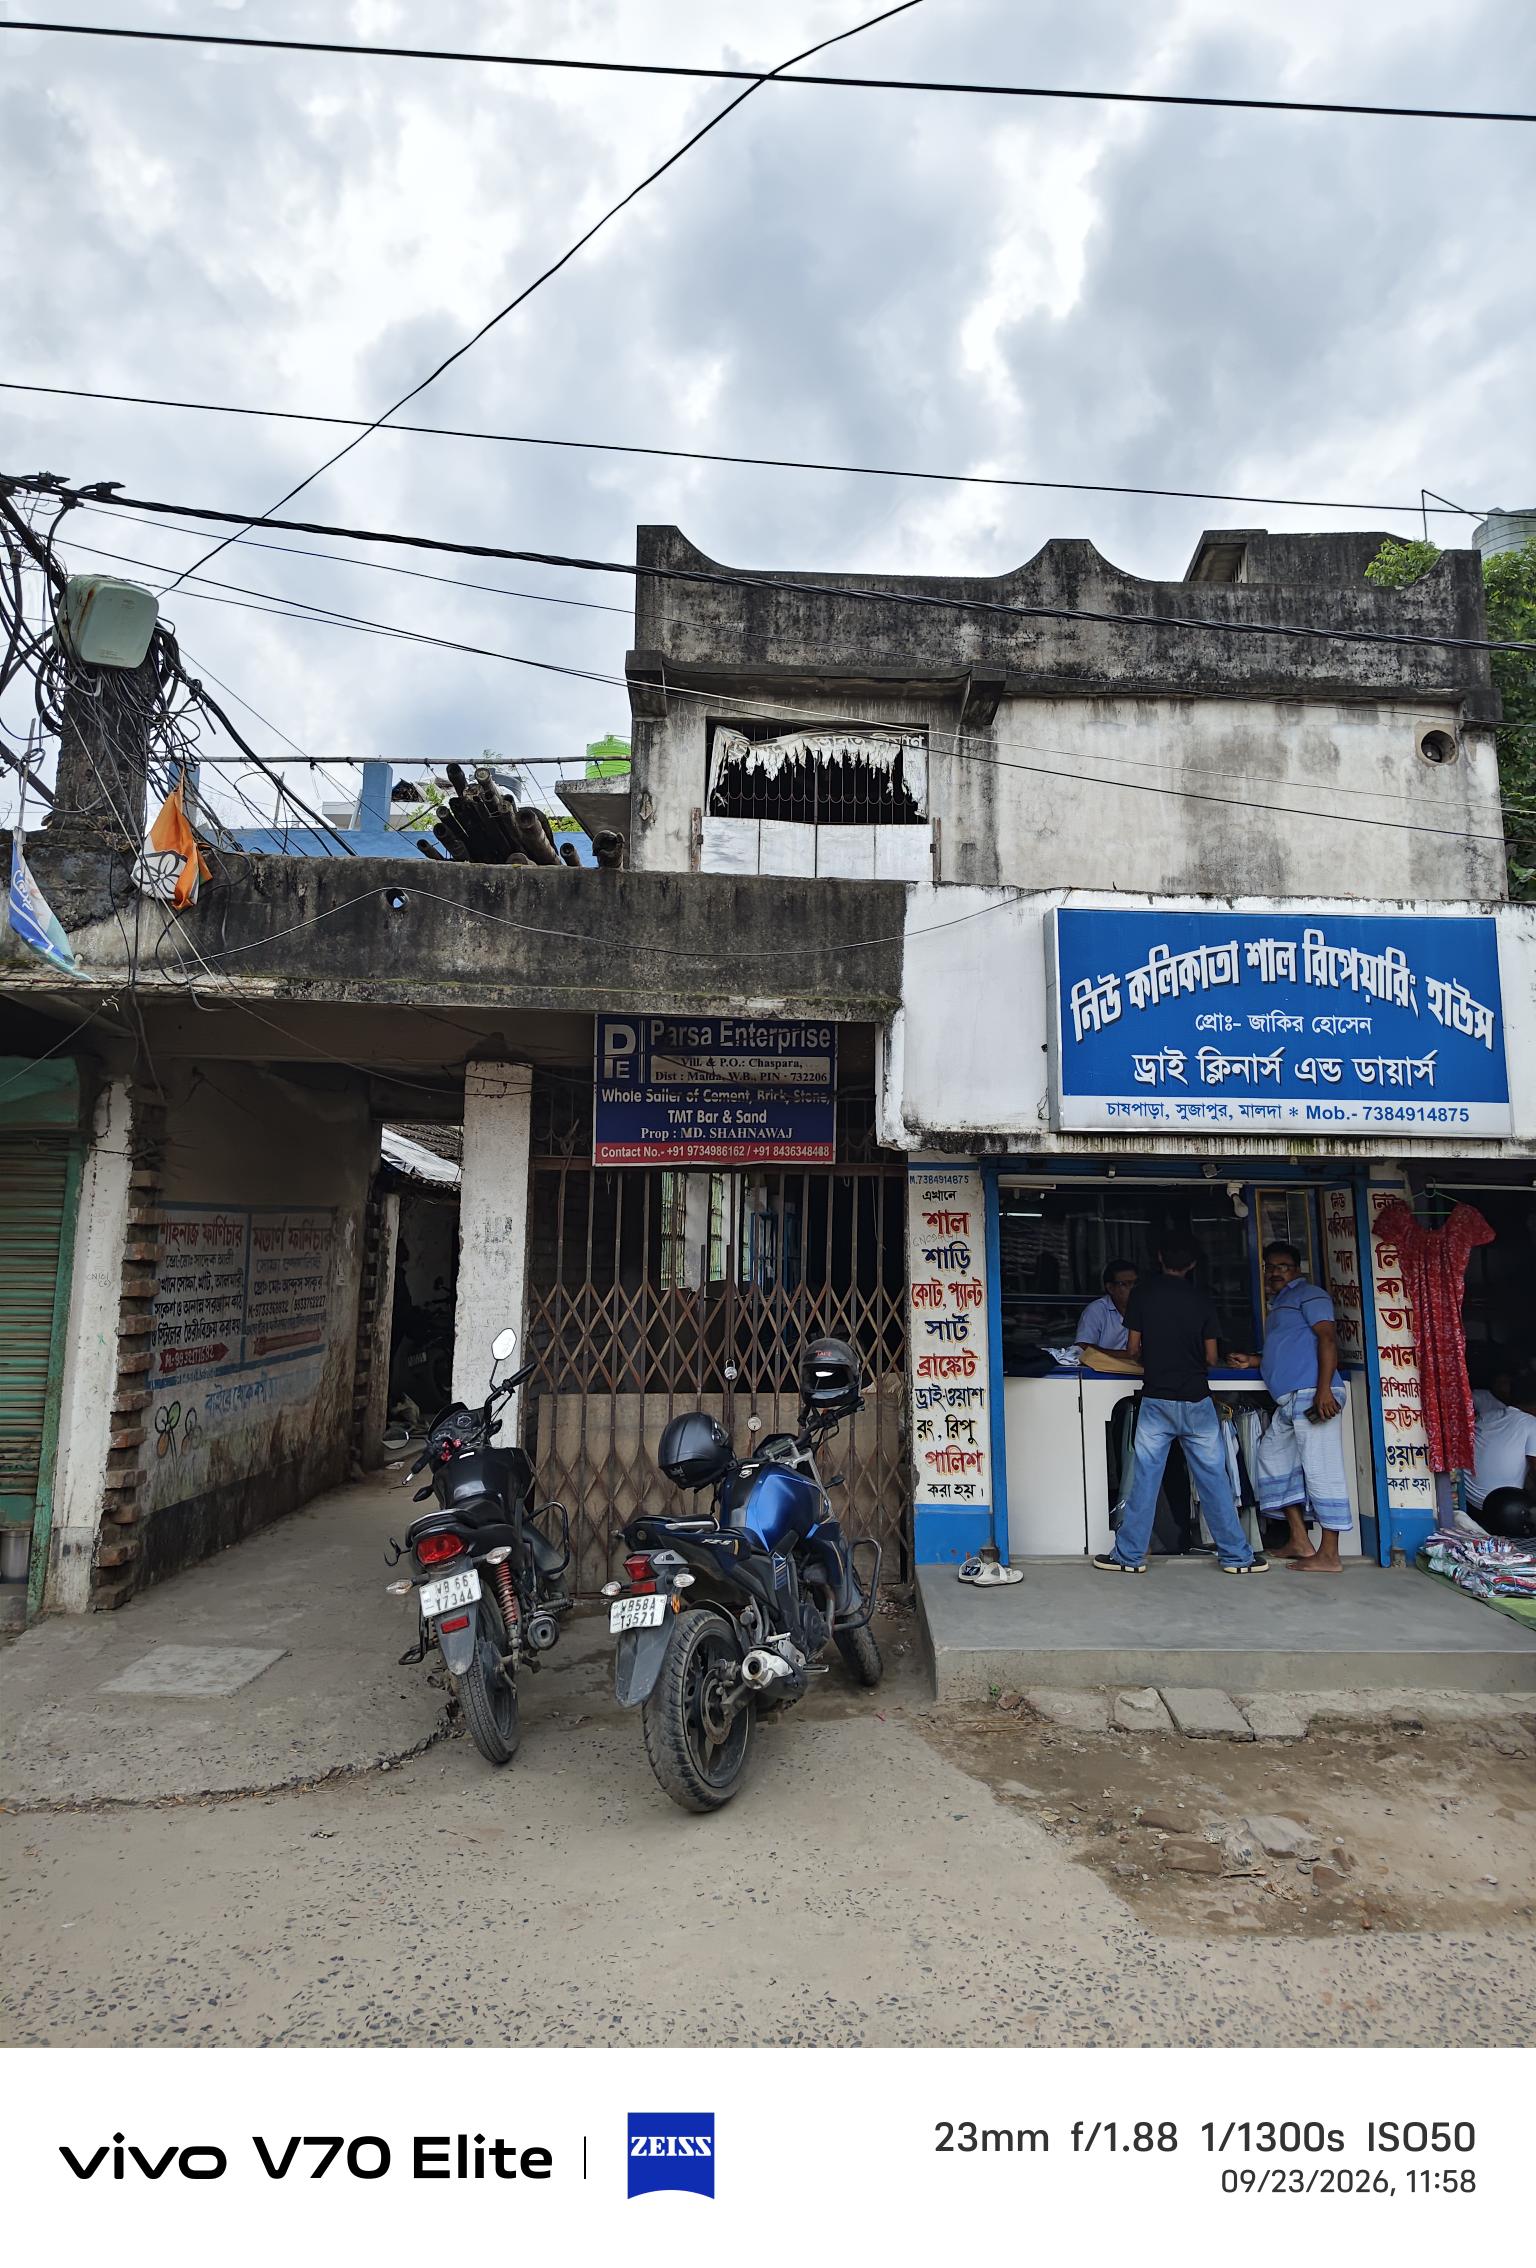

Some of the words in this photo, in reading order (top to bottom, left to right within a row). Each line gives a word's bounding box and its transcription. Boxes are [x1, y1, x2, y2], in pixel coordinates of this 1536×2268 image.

[1070, 973, 1122, 1042] নিউ
[1125, 943, 1240, 1010] কলিকাতা
[1244, 938, 1297, 982] শাল
[1302, 928, 1419, 1018] রিপেয়ারিং
[1425, 976, 1495, 1050] হাউস
[1247, 1010, 1304, 1033] জাকির
[1311, 1015, 1372, 1036] হোসেন
[650, 1019, 713, 1046] Parsa
[719, 1020, 831, 1054] Enterprise
[748, 1058, 803, 1069] Chaspara,
[1131, 1046, 1188, 1087] ড্রাই
[1195, 1045, 1285, 1086] ক্লিনার্স
[1294, 1056, 1344, 1085] এন্ড
[1350, 1049, 1438, 1087] ডায়ার্স
[655, 1071, 678, 1081] Dist
[760, 1072, 780, 1081] PIN
[790, 1072, 828, 1082] 732206
[602, 1088, 642, 1102] Whole
[667, 1109, 693, 1124] TMT
[697, 1110, 718, 1124] Bar
[722, 1110, 732, 1124] &
[736, 1109, 767, 1124] Sand
[1105, 1102, 1170, 1120] চাষপাড়া,
[1175, 1103, 1233, 1120] সুজাপুর,
[1239, 1104, 1282, 1119] মালদা
[1306, 1105, 1357, 1120] Mob.-
[1363, 1106, 1470, 1122] 7384914875
[641, 1128, 669, 1141] Prop
[681, 1127, 706, 1139] MD.
[709, 1127, 793, 1139] SHAHNAWAJ
[602, 1146, 641, 1158] Contact
[667, 1145, 685, 1157] +91
[687, 1145, 745, 1157] 9734986162
[753, 1146, 771, 1156] +91
[922, 1190, 958, 1202] এখানে
[922, 1209, 971, 1236] শাল
[921, 1240, 971, 1276] শাড়ি
[948, 1276, 984, 1312] প্যান্ট
[924, 1313, 970, 1341] সার্ট
[1378, 1344, 1418, 1367] শাল
[1380, 1376, 1421, 1398] রিপিয়ারি
[1384, 1404, 1425, 1430] হাউস
[944, 1414, 978, 1446] রিপু
[925, 1445, 985, 1475] পালিশ
[1386, 1443, 1429, 1467] ওয়াশ
[927, 1483, 951, 1498] করা
[1387, 1476, 1410, 1491] করা
